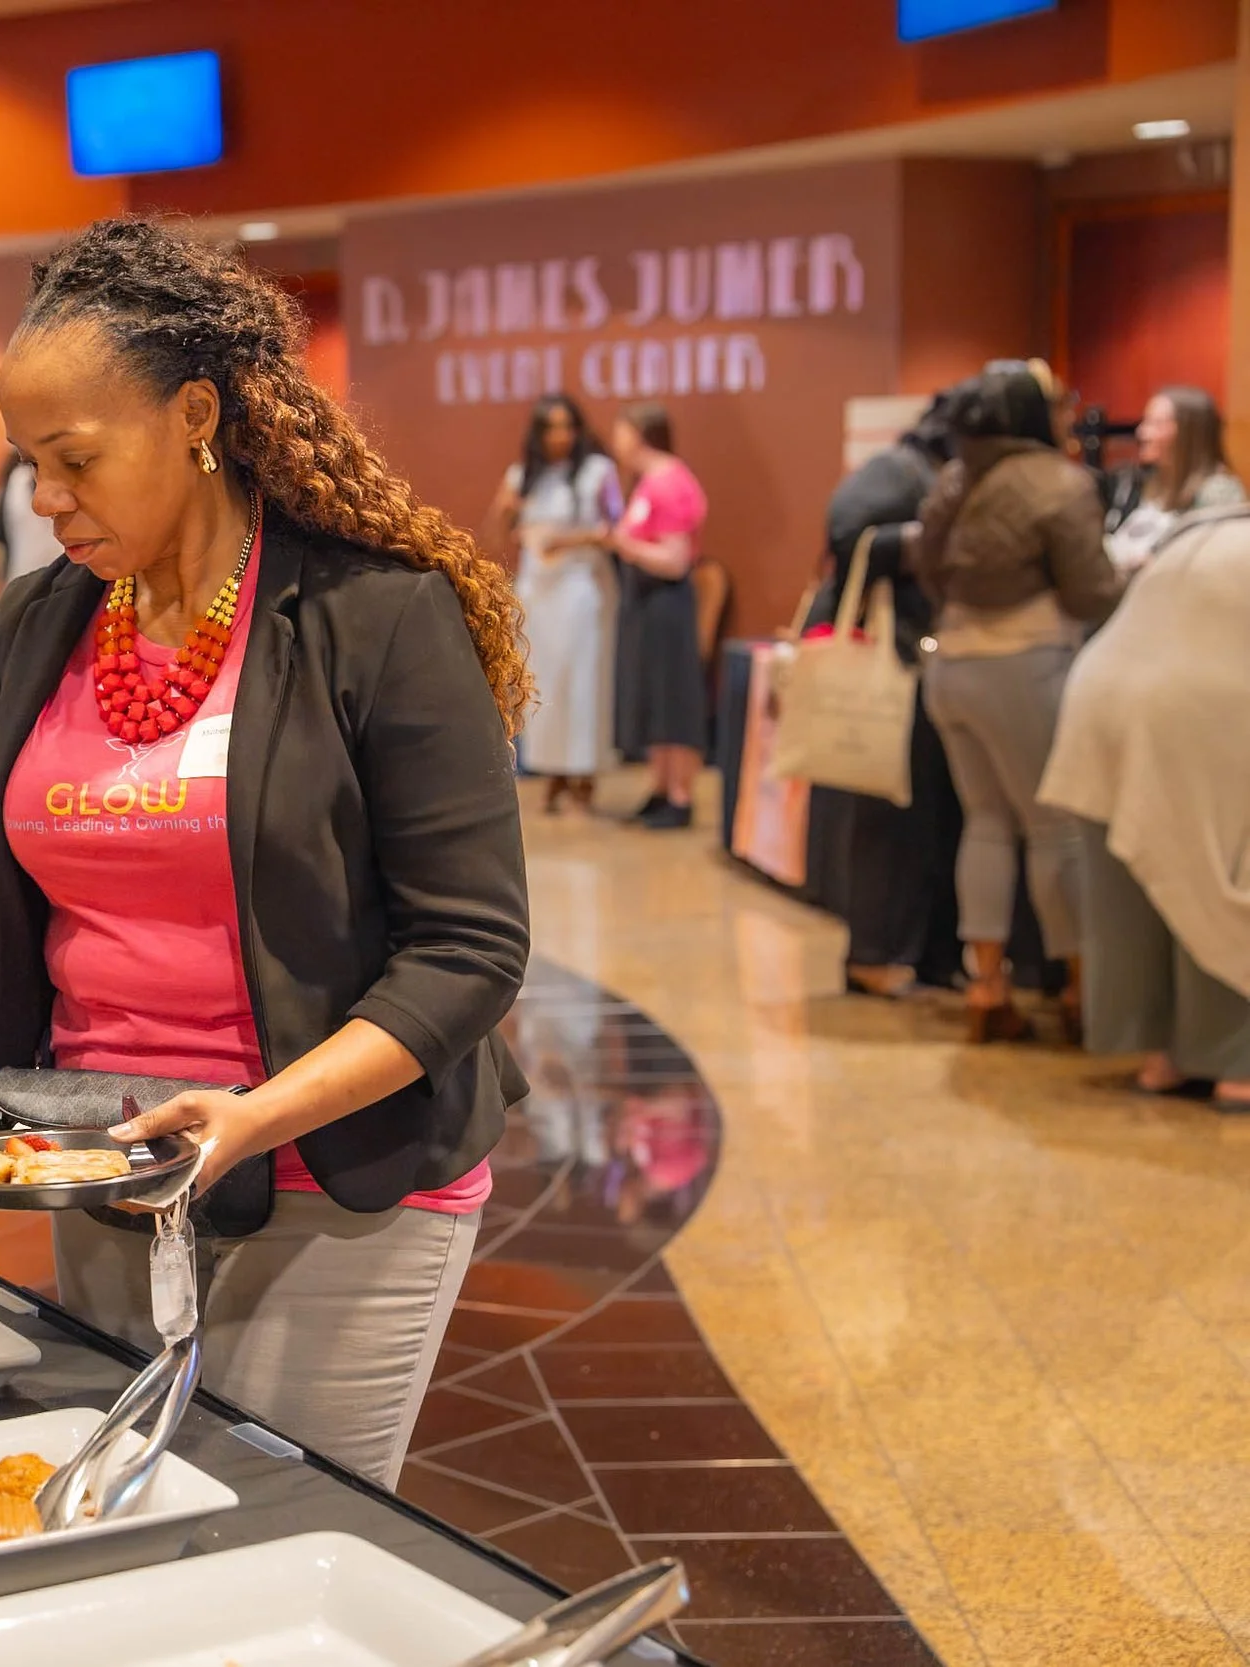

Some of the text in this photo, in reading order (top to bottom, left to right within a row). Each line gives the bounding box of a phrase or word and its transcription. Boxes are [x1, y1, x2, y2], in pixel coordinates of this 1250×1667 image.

[418, 254, 611, 342] JAMES
[580, 332, 767, 401] CENTER
[45, 778, 189, 816] GLOW
[53, 817, 115, 834] Leading
[119, 817, 131, 831] &
[136, 815, 201, 832] Owning
